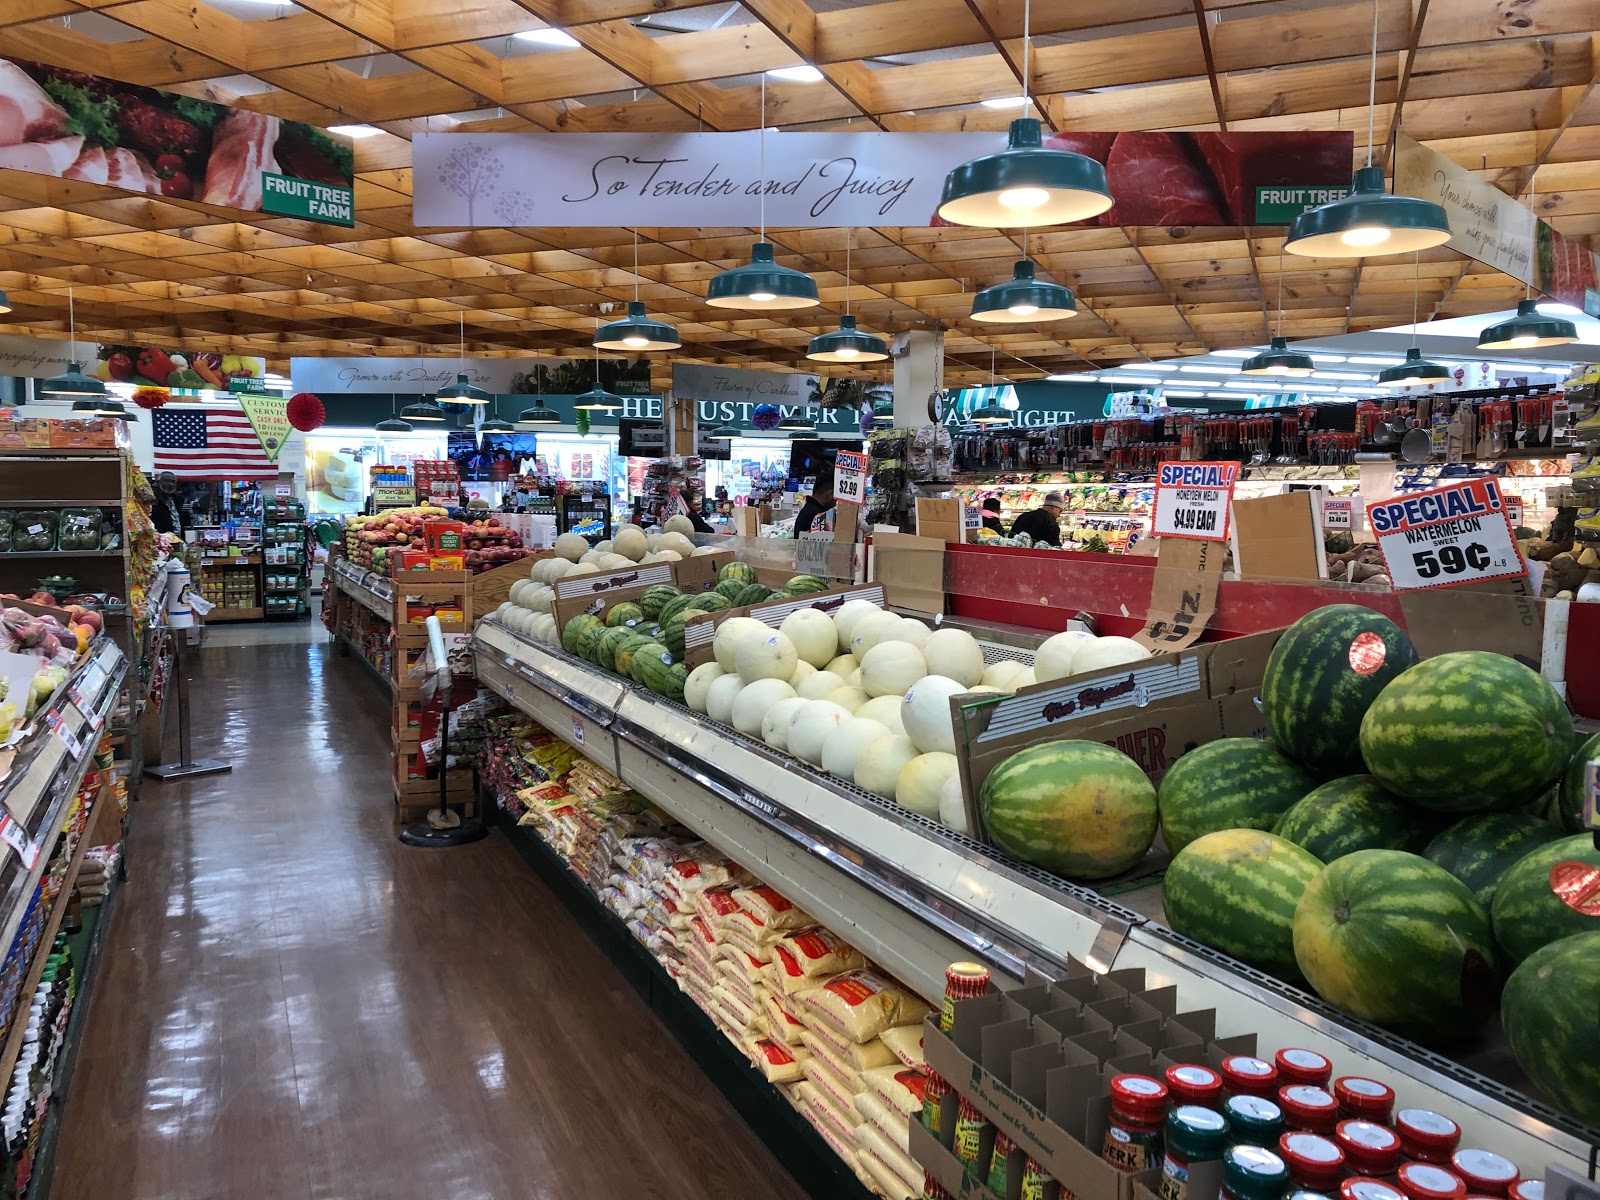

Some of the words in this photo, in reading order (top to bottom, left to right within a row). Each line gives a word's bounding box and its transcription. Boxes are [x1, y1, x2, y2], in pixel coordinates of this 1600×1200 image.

[265, 176, 312, 198] FRUIT
[313, 186, 350, 205] TREE
[562, 155, 629, 203] So
[633, 157, 740, 197] Tender
[745, 163, 816, 196] and
[810, 156, 914, 218] Juicy
[1260, 190, 1305, 204] FRUIT
[1308, 190, 1348, 203] TREE
[309, 200, 350, 220] FARM
[338, 367, 379, 388] Grown
[407, 367, 454, 386] Quality
[247, 400, 288, 408] CUSTOM
[253, 408, 286, 416] SERVIC
[604, 397, 662, 418] HE
[836, 453, 867, 471] SPECIAL!
[1161, 465, 1234, 487] SPECIAL!
[839, 480, 858, 496] $2.99
[1176, 489, 1202, 500] HONEYDEW
[1203, 490, 1219, 501] MELON
[1372, 482, 1502, 532] SPECIAL!
[572, 520, 605, 535] Snapple
[1174, 507, 1196, 529] $4.99
[1196, 509, 1217, 531] EACH
[1404, 517, 1482, 544] WATERMELON
[1433, 537, 1459, 547] SWEET
[1198, 540, 1209, 572] QUAL
[1412, 541, 1491, 578] 59¢
[1104, 1143, 1137, 1167] JERK
